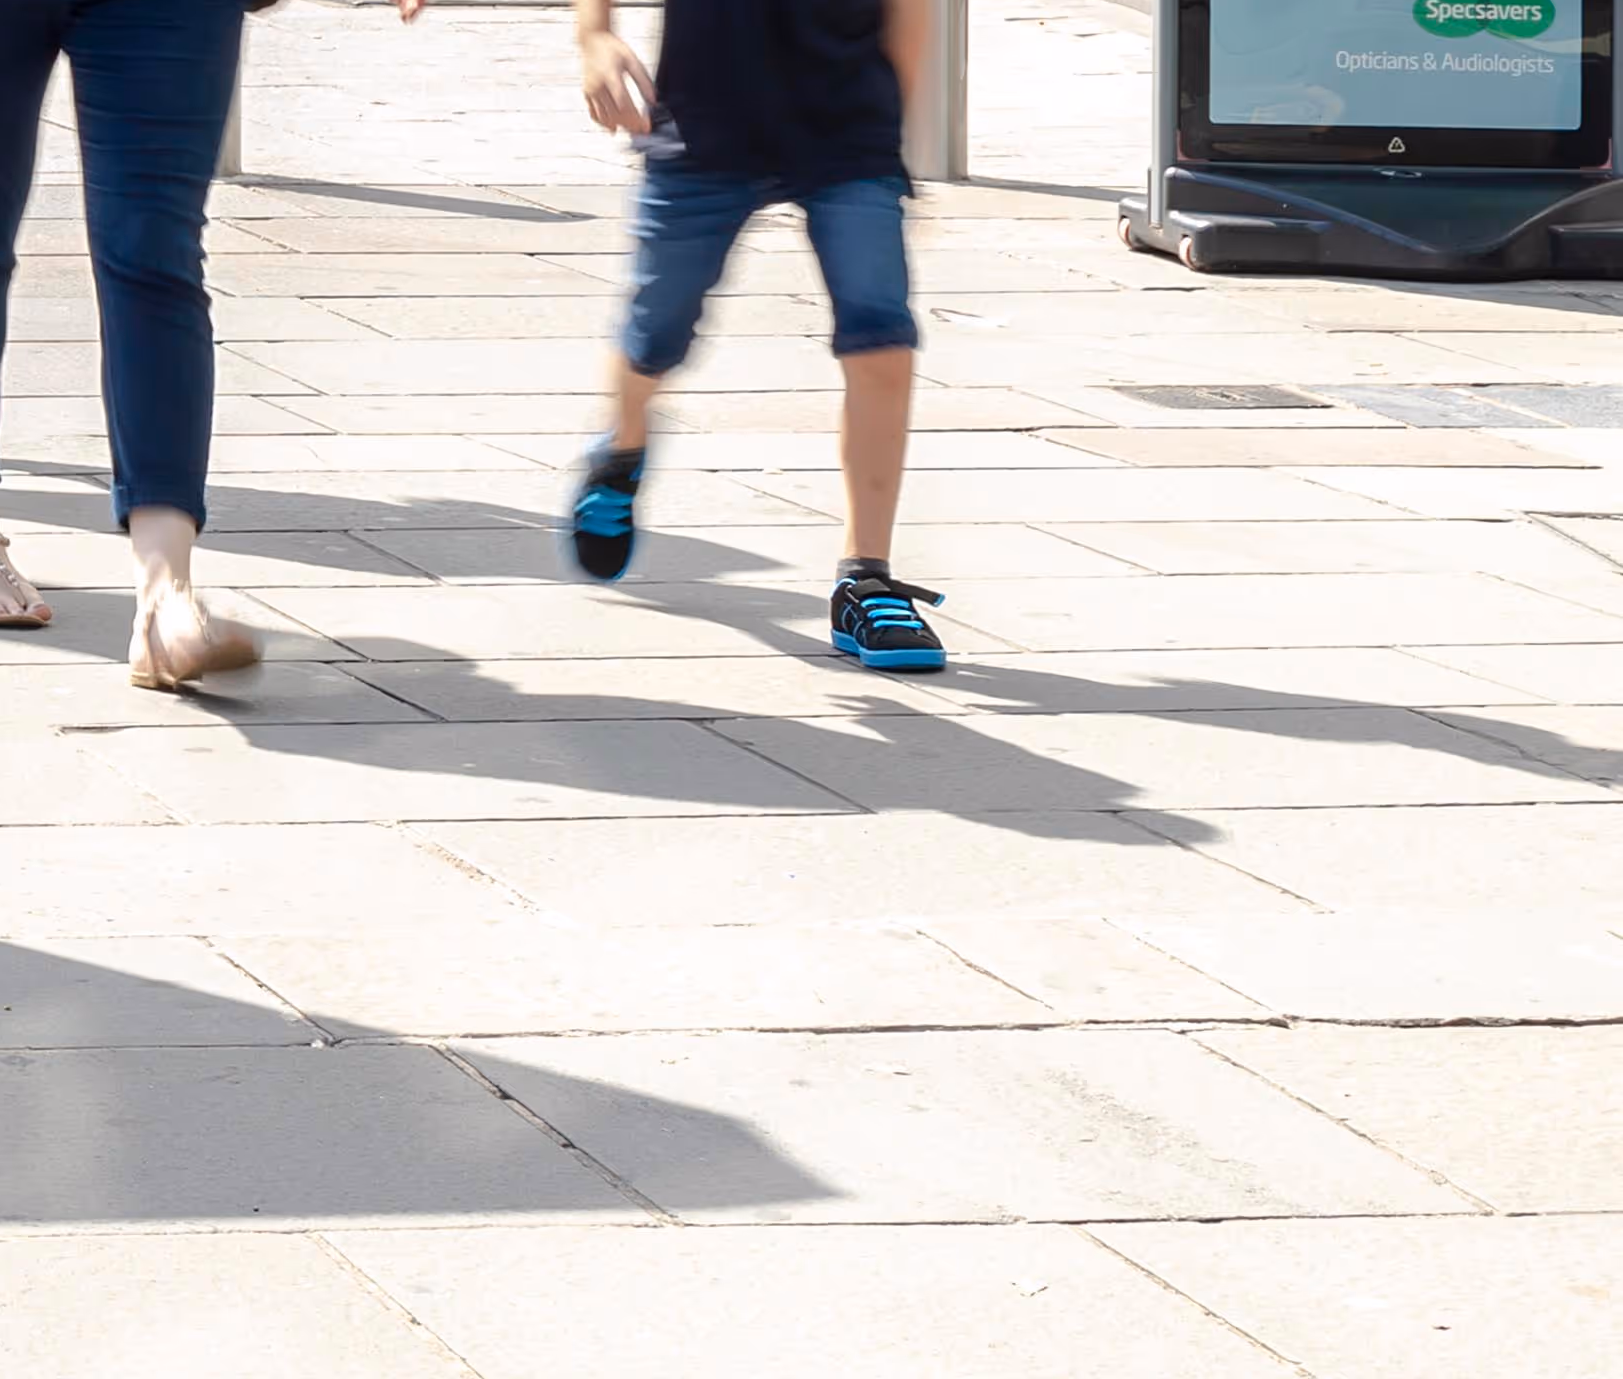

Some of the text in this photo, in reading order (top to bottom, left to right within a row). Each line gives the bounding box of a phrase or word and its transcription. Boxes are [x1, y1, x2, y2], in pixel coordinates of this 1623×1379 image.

[1335, 50, 1556, 77] Opticians & Audiologists
